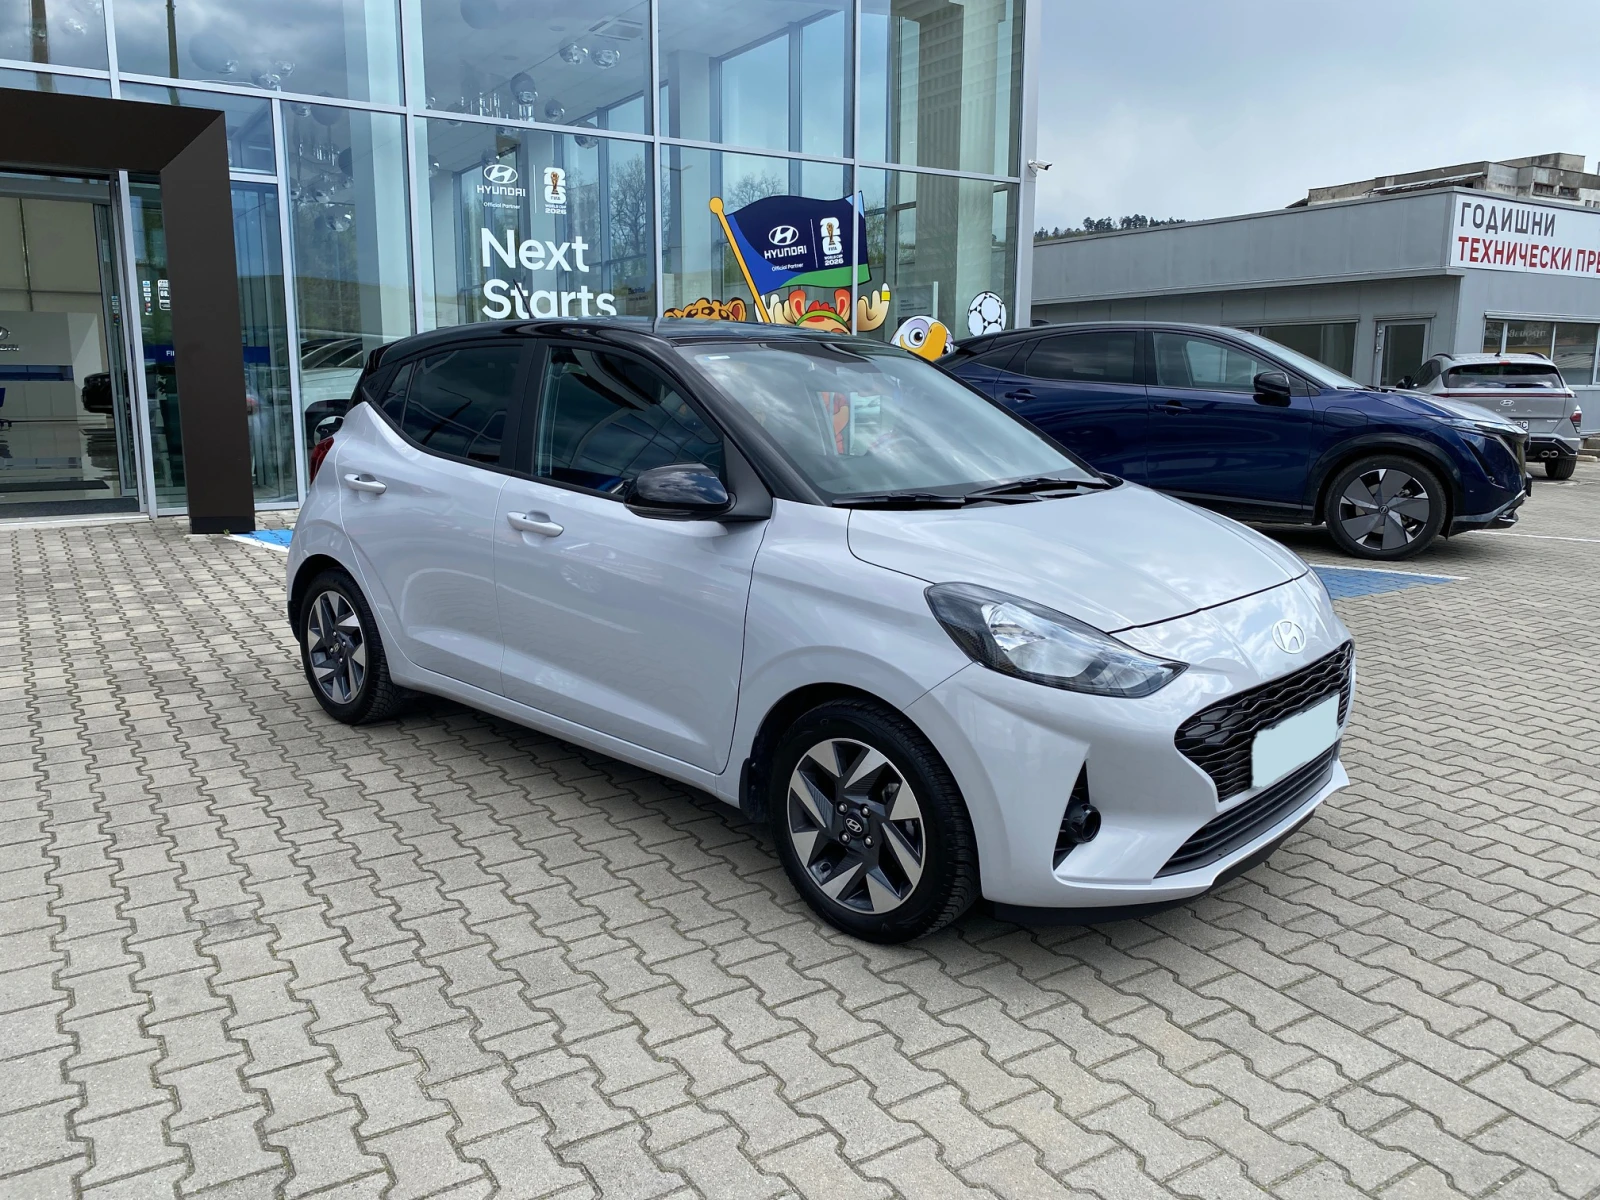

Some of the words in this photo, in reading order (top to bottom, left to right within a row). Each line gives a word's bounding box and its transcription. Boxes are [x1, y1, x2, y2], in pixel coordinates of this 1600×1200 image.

[476, 184, 526, 197] HYUNDAI
[1460, 201, 1556, 237] ГОДИШНИ
[481, 227, 590, 273] Next
[763, 244, 808, 260] HYUNDAI
[824, 258, 844, 266] 2026
[1457, 236, 1572, 271] ТЕХНИЧЕСКИ
[481, 278, 618, 320] Starts
